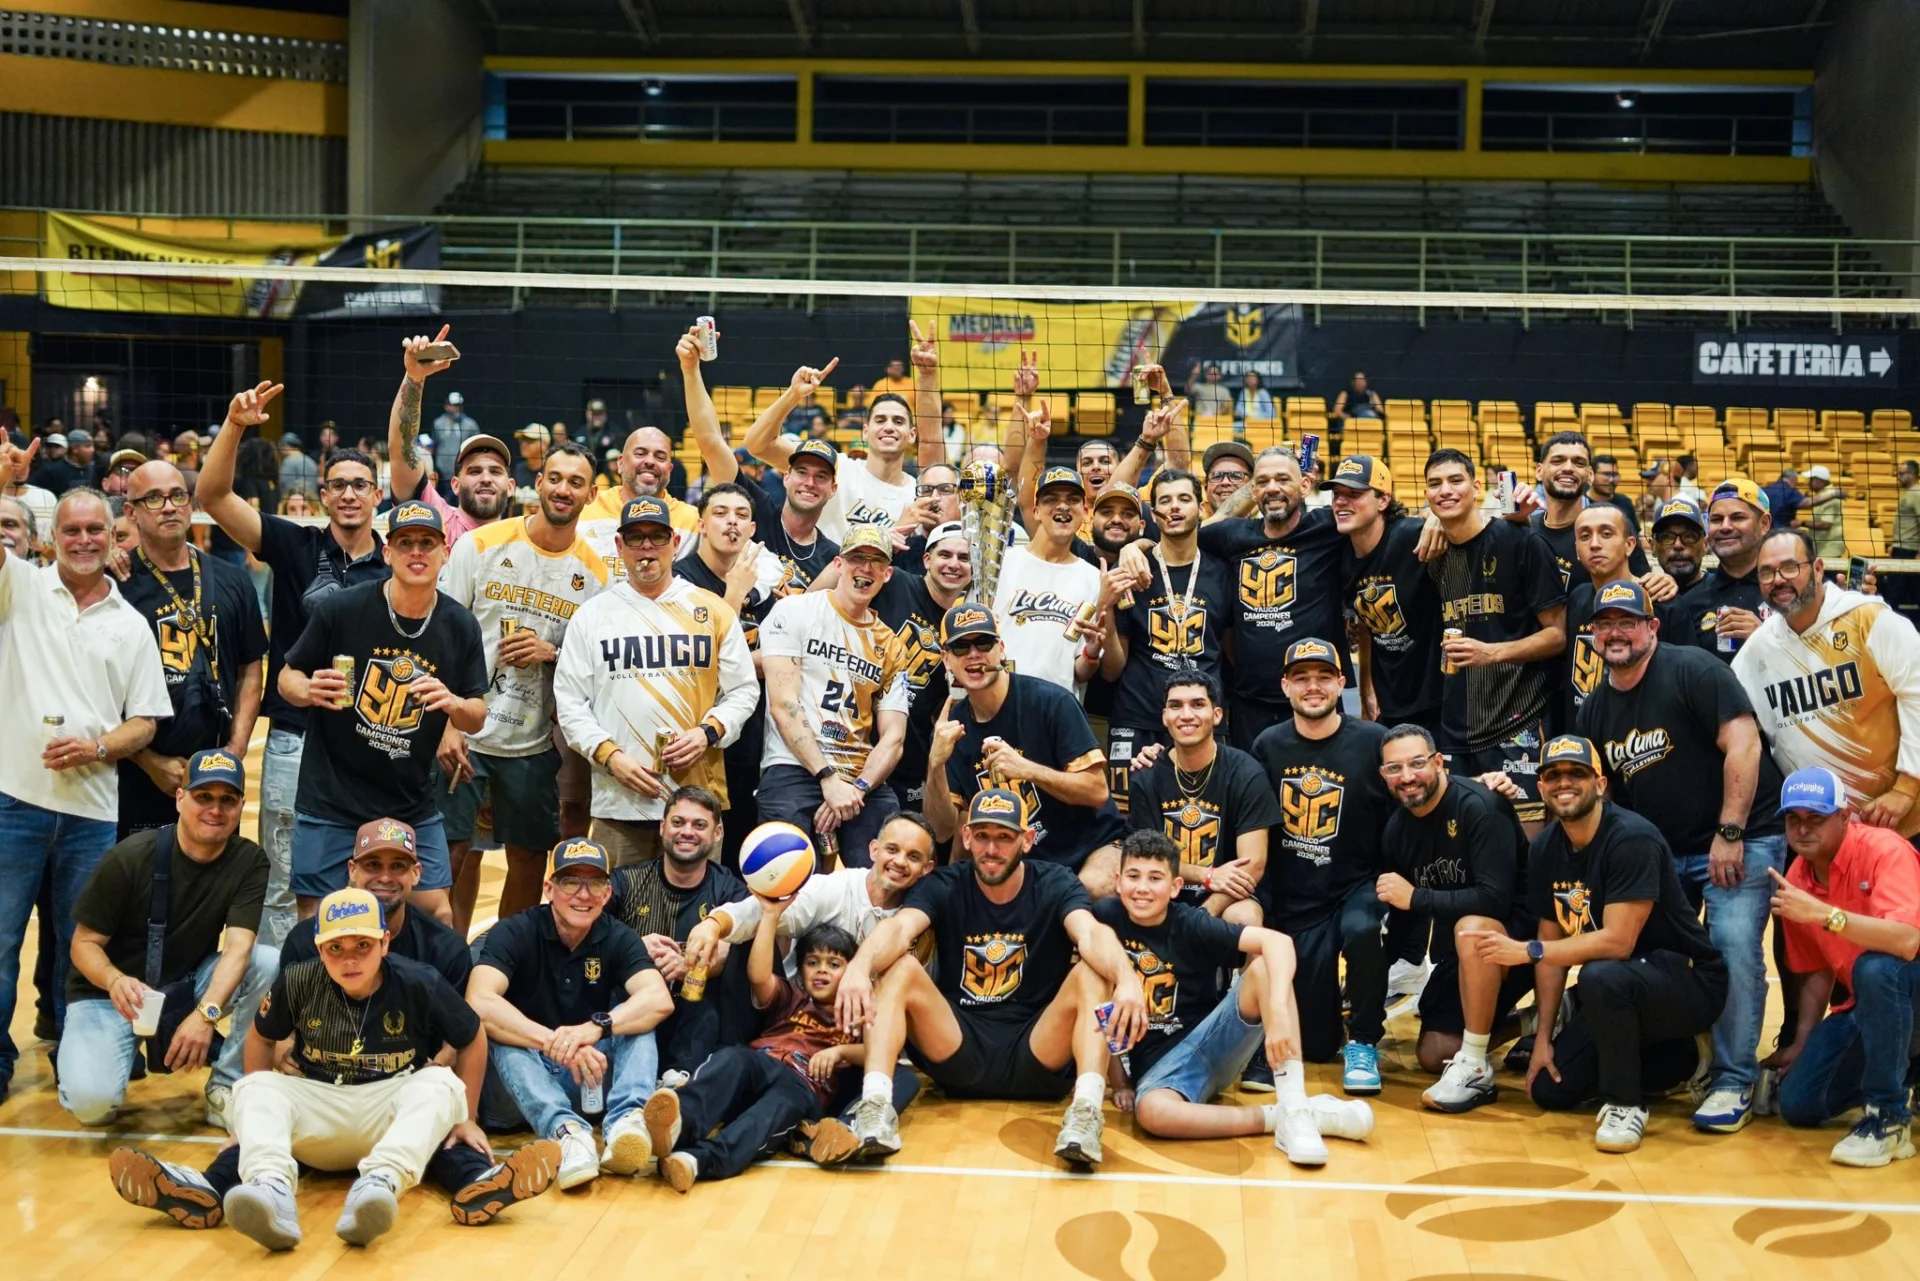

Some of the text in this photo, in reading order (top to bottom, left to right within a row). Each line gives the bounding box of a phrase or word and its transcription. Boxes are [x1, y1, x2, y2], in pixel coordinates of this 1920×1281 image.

[950, 314, 1034, 333] MEDALLA
[1699, 341, 1865, 377] CAFETERIA
[1243, 611, 1290, 620] CAMPEONES
[601, 634, 713, 672] YAUCO
[807, 638, 883, 684] CAFEEROS
[821, 679, 859, 720] 24
[1764, 660, 1865, 718] YAUCO
[370, 721, 399, 737] YAUCO
[1777, 711, 1826, 729] OLLEYBALL
[355, 723, 411, 750] CAMPEONES
[1282, 839, 1330, 855] CAMPEONES
[1295, 835, 1319, 845] YAUCO
